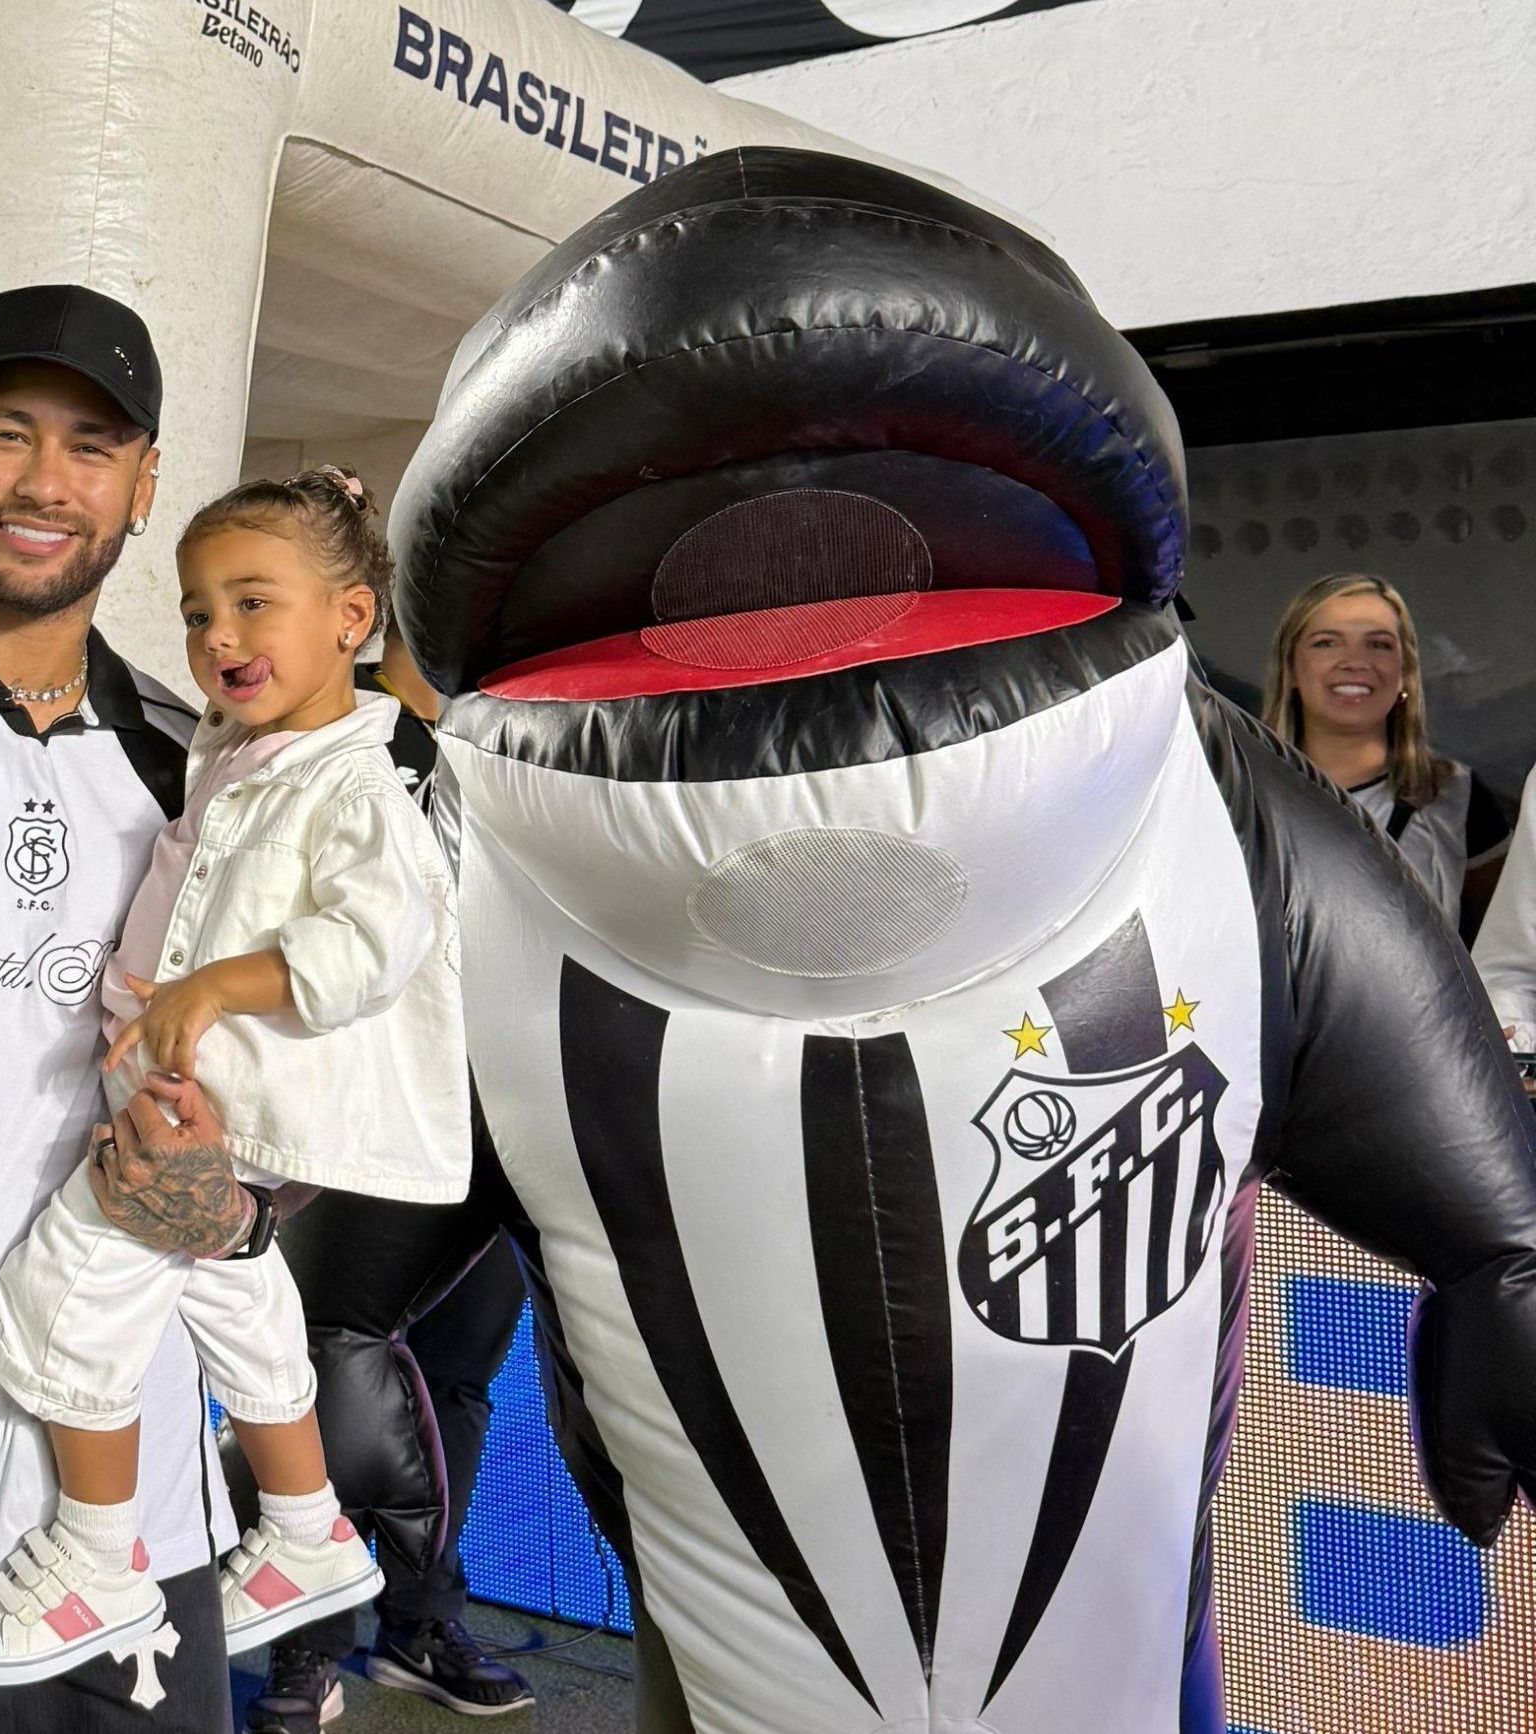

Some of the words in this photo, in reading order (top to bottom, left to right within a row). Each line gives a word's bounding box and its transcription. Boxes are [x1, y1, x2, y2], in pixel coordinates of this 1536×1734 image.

[202, 12, 263, 68] Betano
[393, 6, 707, 185] BRASILEIR
[16, 898, 54, 912] S.F.C.
[986, 1067, 1204, 1283] S.F.C.
